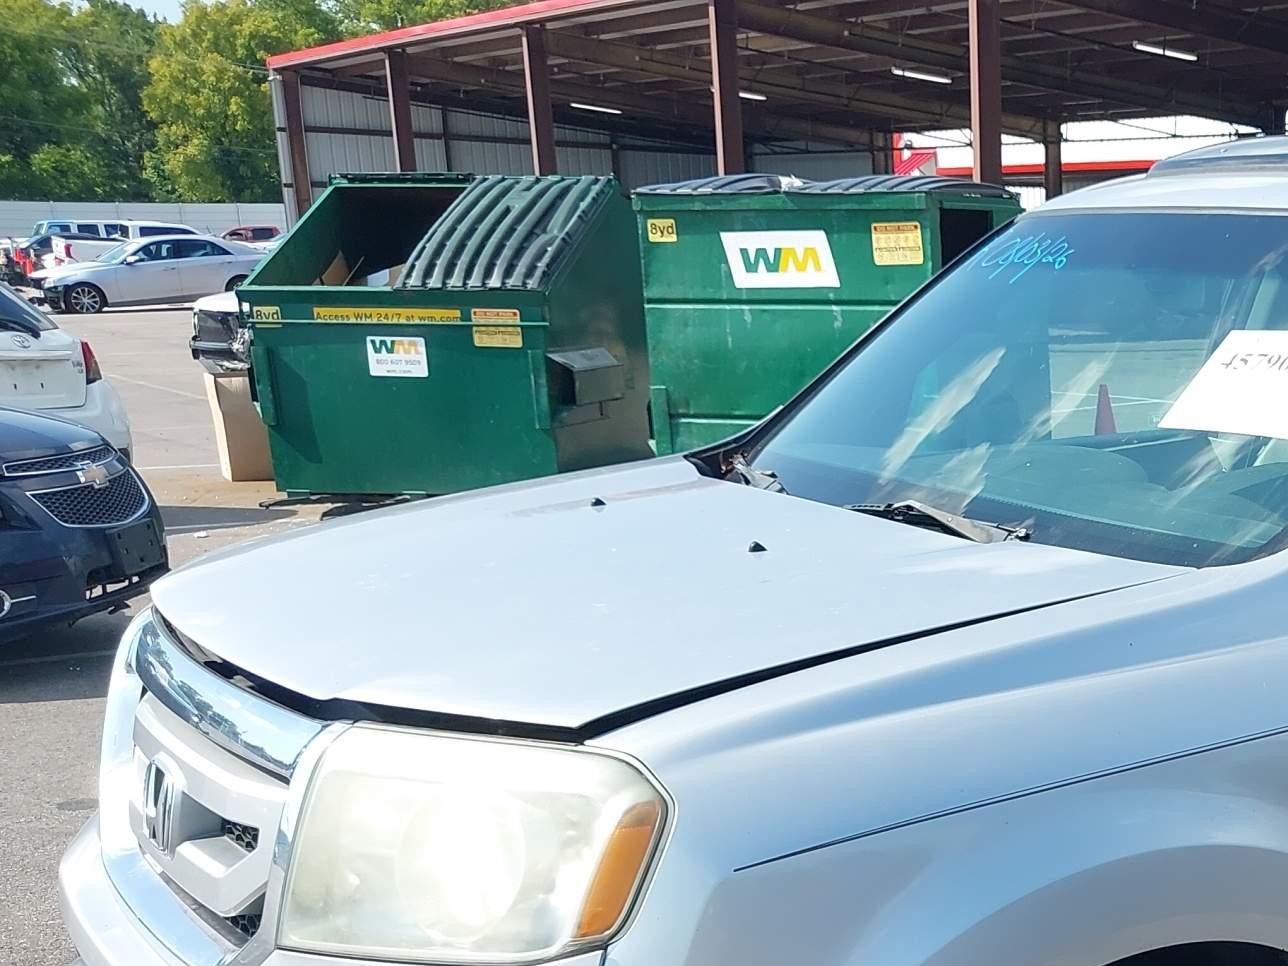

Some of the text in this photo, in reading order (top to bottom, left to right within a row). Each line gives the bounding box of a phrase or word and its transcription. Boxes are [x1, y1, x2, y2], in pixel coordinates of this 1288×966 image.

[650, 223, 674, 237] 8yd
[739, 247, 822, 273] WM
[315, 311, 351, 321] Access
[353, 312, 373, 321] WM
[376, 312, 401, 322] 24/7
[406, 313, 417, 322] at
[370, 339, 422, 354] WM
